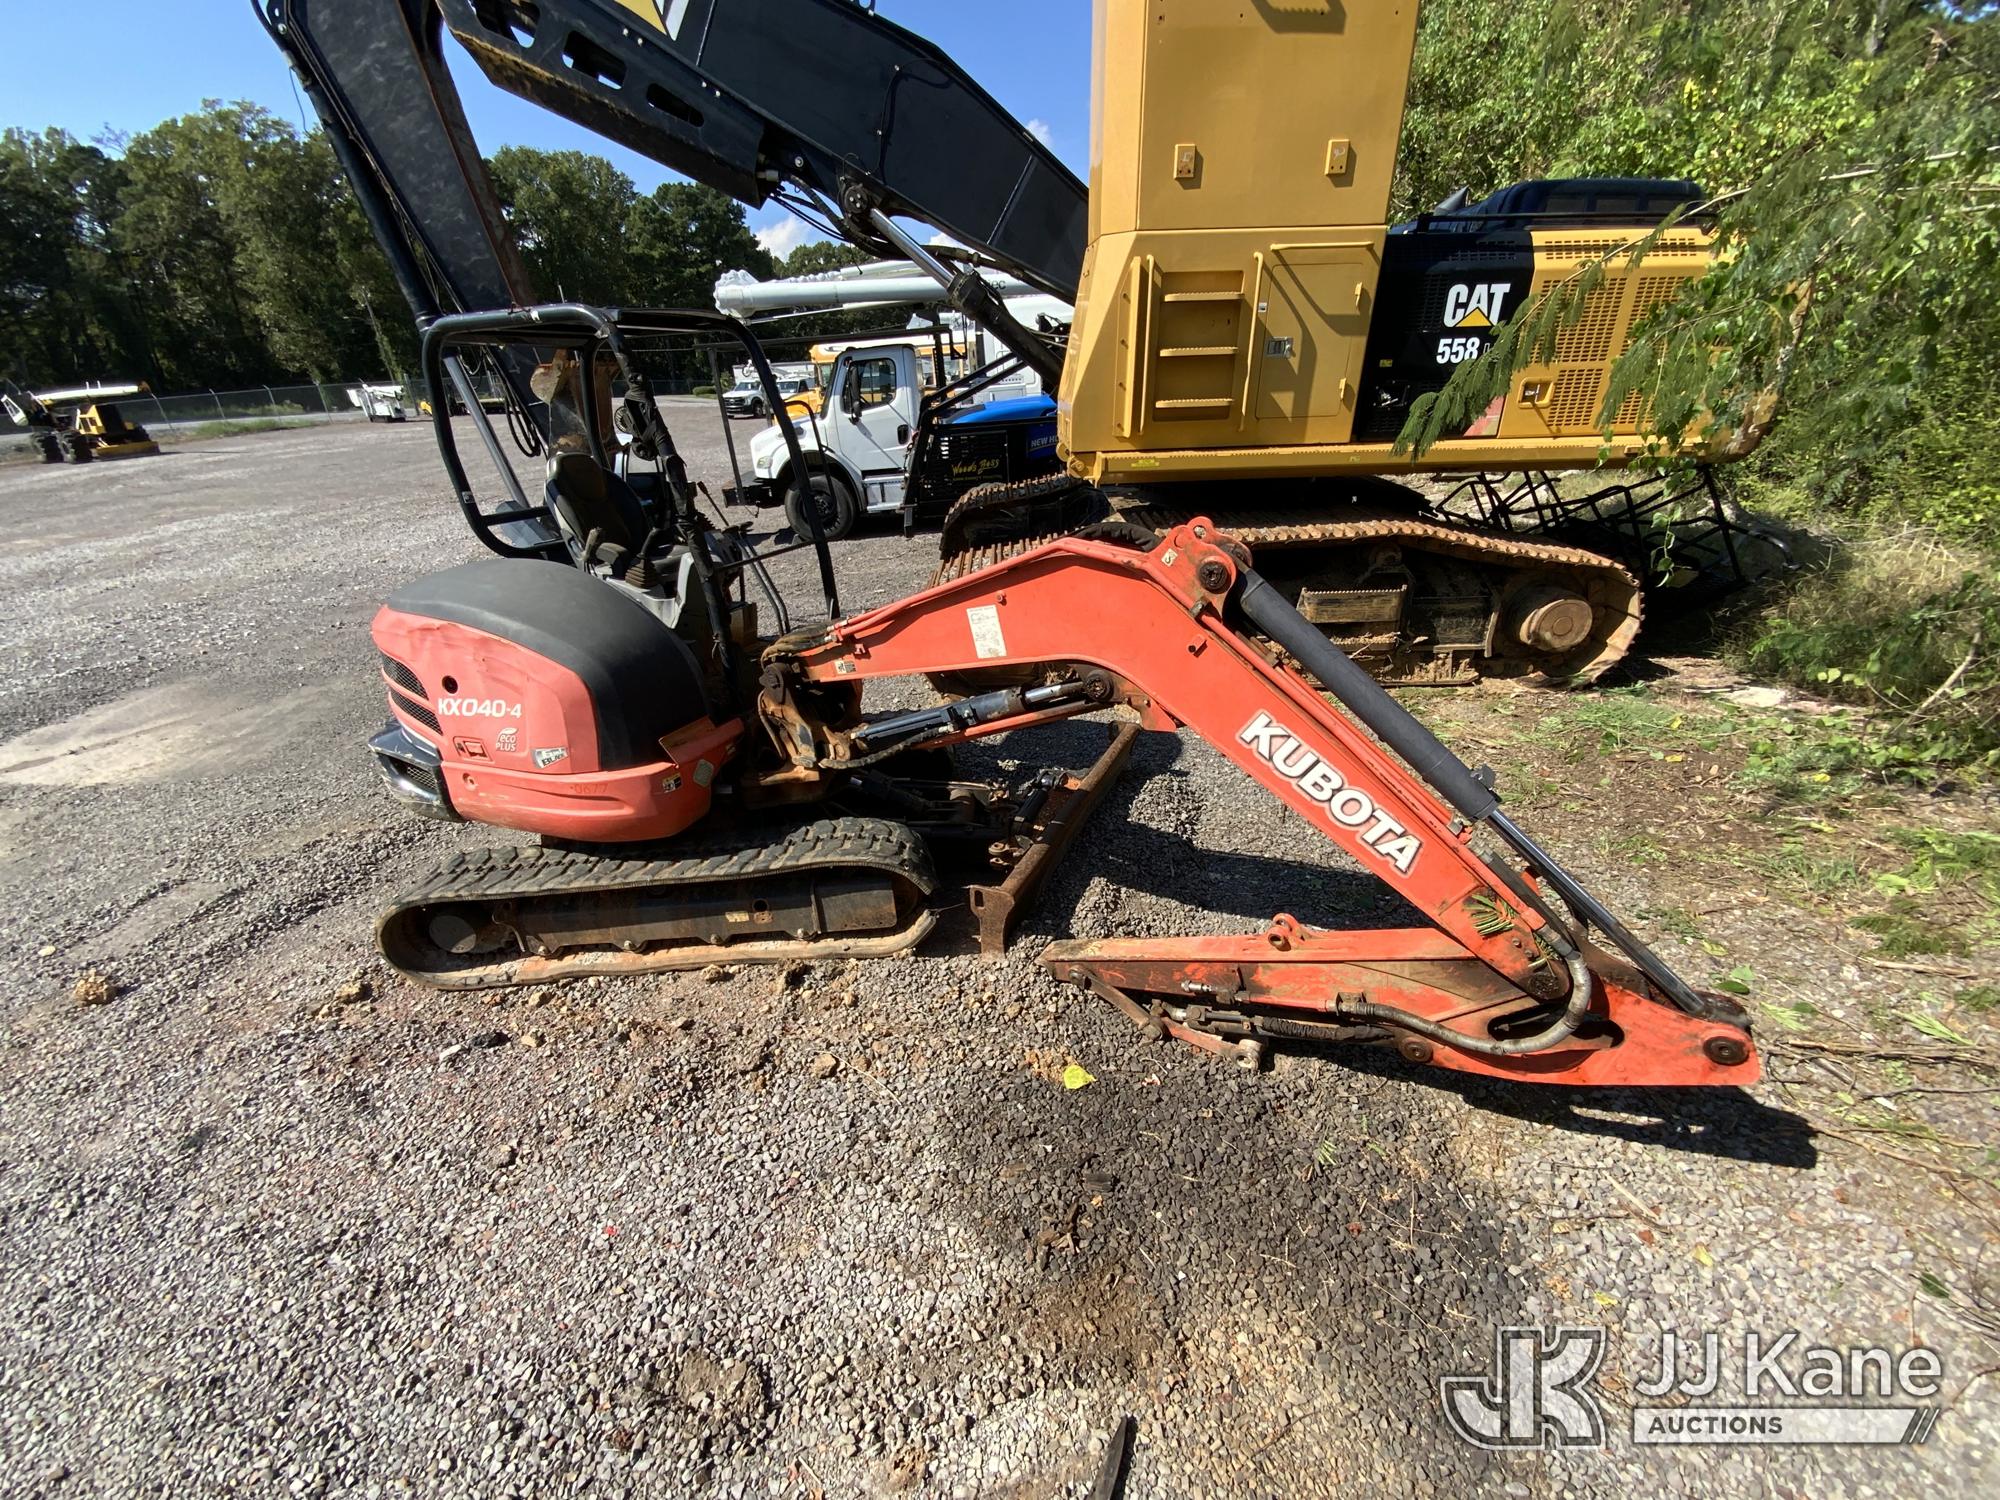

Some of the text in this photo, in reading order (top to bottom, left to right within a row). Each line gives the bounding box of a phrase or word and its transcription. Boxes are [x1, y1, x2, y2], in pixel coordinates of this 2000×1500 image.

[990, 280, 1007, 290] ec
[1443, 283, 1511, 328] CAT
[1436, 336, 1480, 364] 558
[1030, 436, 1048, 448] NEW
[437, 697, 522, 719] KX040-4
[495, 742, 516, 752] PLUS
[499, 734, 516, 744] eco
[1239, 710, 1423, 874] KUBOTA
